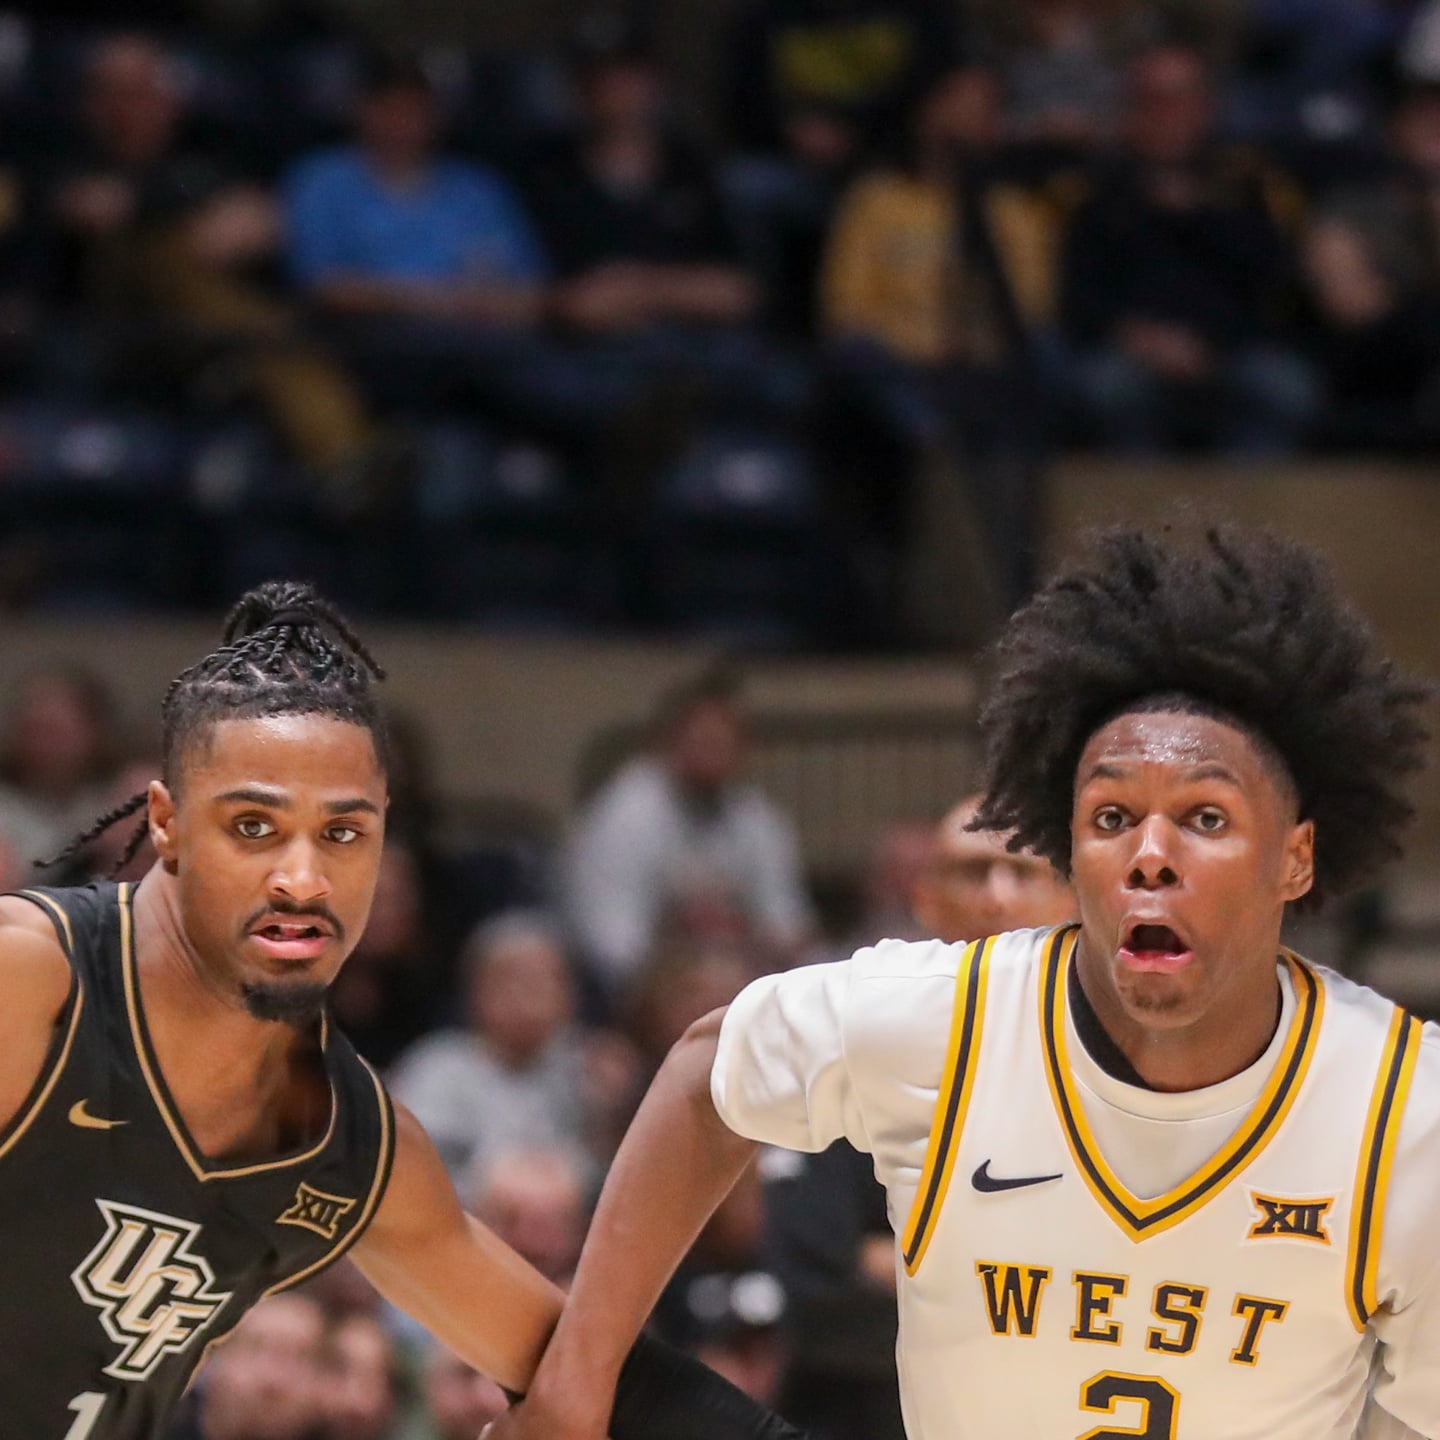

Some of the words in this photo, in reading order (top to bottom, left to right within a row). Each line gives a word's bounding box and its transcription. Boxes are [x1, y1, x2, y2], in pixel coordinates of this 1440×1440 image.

[275, 1181, 357, 1239] XII
[1246, 1191, 1335, 1246] XII
[70, 1197, 235, 1382] UCF
[974, 1259, 1291, 1367] WEST
